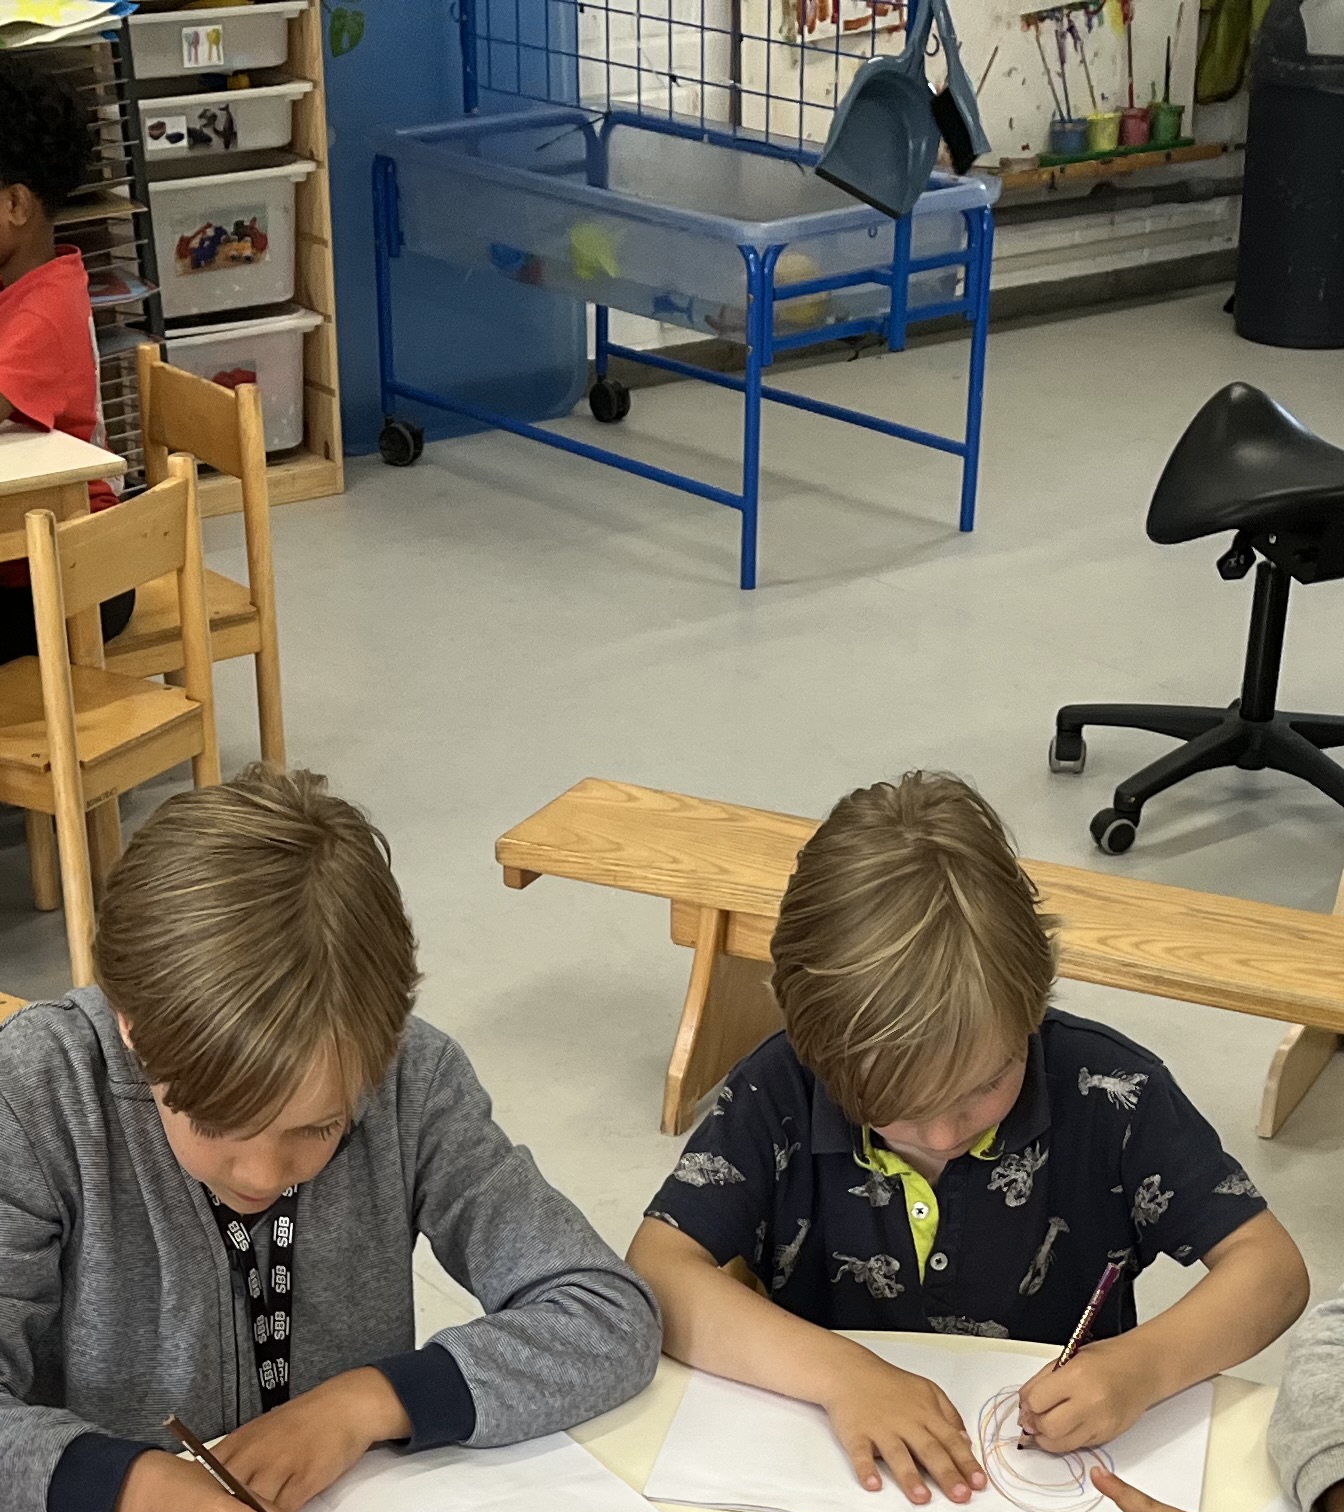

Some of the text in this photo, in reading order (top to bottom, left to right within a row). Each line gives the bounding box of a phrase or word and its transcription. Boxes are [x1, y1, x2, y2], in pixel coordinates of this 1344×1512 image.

[228, 1220, 250, 1252] SBB
[277, 1216, 291, 1248] SBB
[276, 1265, 286, 1294] SBB
[274, 1311, 286, 1340] SBB
[262, 1360, 276, 1390] SBB
